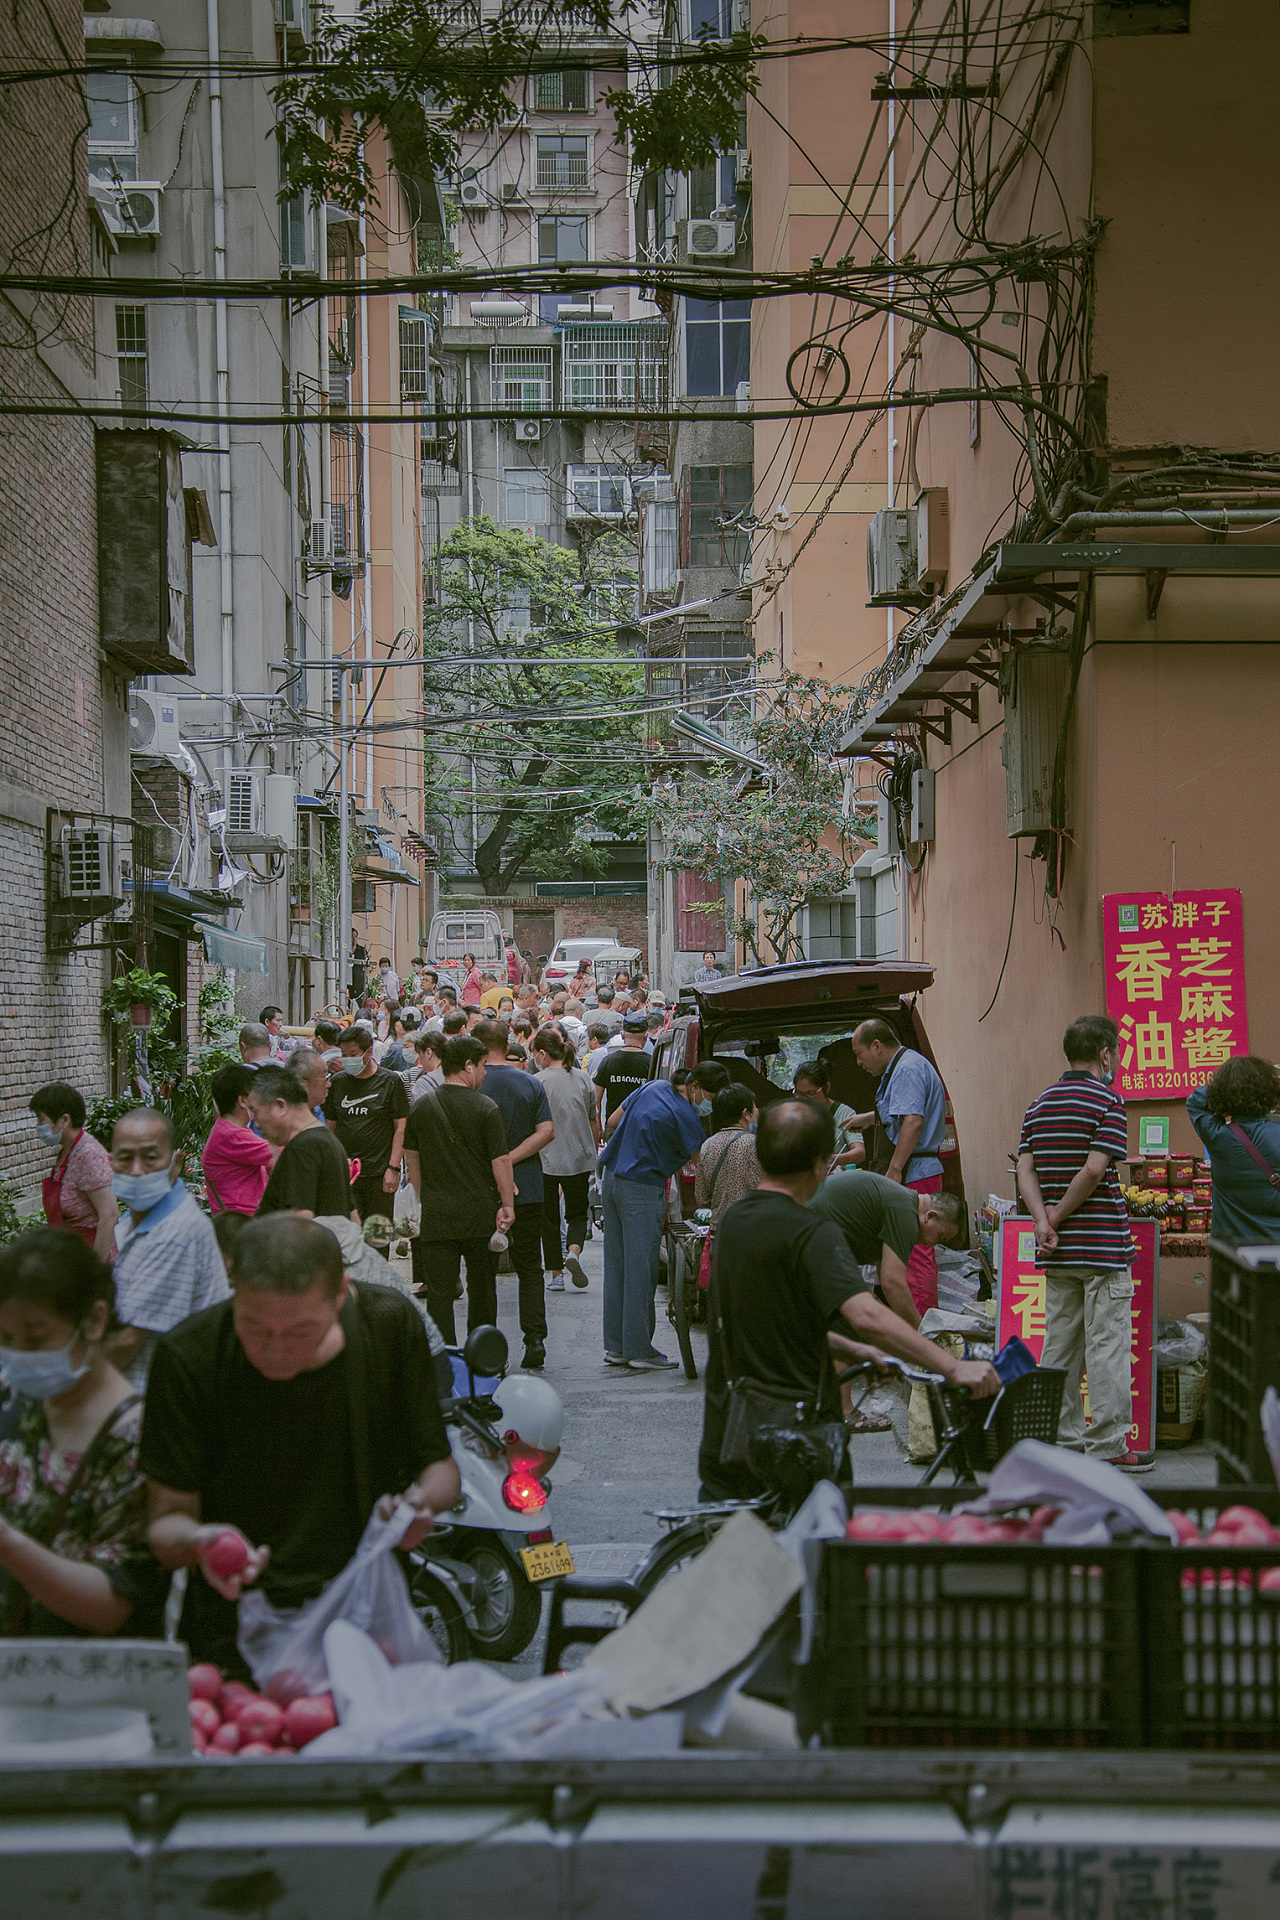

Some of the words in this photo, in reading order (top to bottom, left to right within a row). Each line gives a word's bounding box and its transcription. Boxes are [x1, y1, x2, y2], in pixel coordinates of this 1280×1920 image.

[1141, 901, 1230, 930] 苏胖子
[1115, 940, 1174, 1071] 香油
[1177, 937, 1237, 1069] 芝麻酱
[347, 1107, 369, 1115] AIR
[530, 1557, 573, 1578] 2361699
